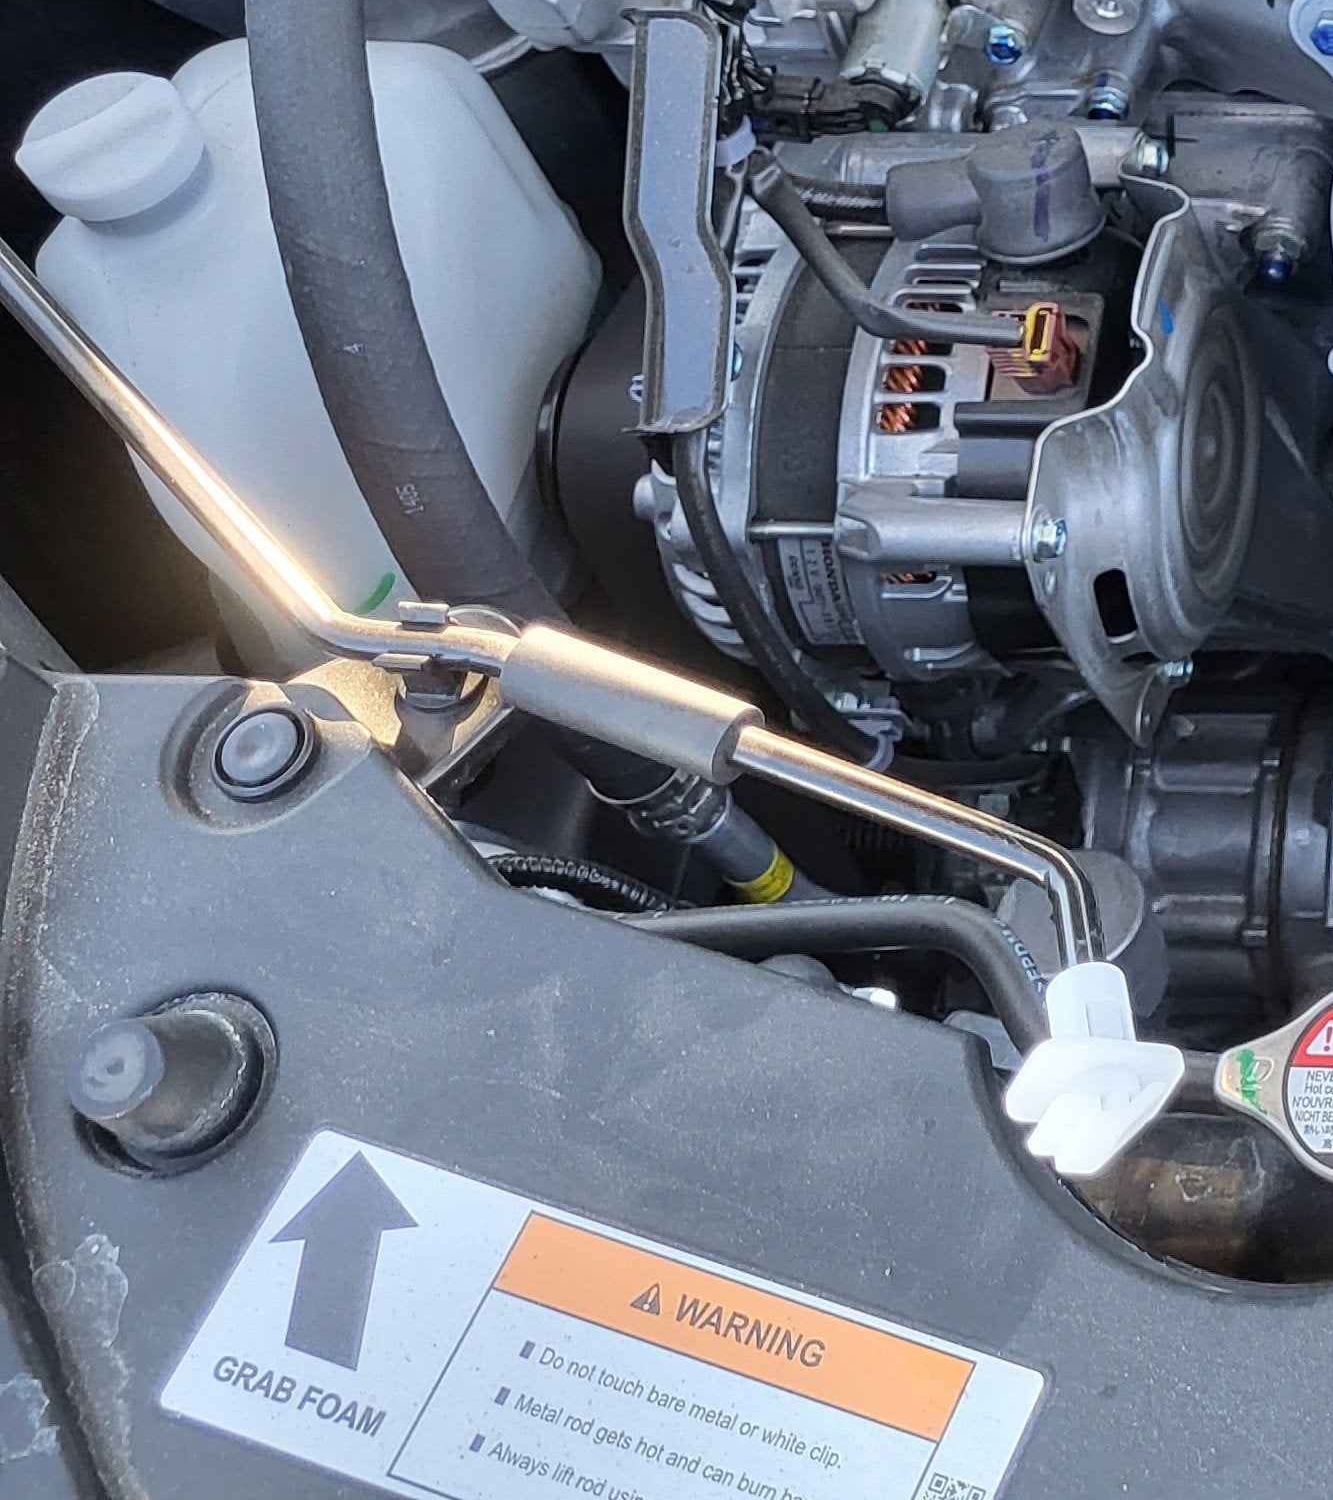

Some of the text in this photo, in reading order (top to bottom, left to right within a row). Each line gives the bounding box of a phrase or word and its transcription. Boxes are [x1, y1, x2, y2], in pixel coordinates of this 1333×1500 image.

[1294, 1110, 1320, 1122] NICHT
[1304, 1082, 1322, 1094] Hot
[675, 1293, 826, 1368] WARNING
[212, 1354, 388, 1438] GRAB FOAM
[538, 1346, 842, 1470] Do not touch bare metal or white clip.
[487, 1441, 551, 1477] Always
[551, 1460, 575, 1487] lift
[574, 1473, 608, 1498] rod
[513, 1392, 564, 1425] Metal
[563, 1413, 596, 1436] rod
[592, 1426, 633, 1451] gets
[634, 1435, 666, 1462] hot
[665, 1450, 701, 1474] and
[702, 1464, 734, 1487] can
[736, 1471, 777, 1500] burn
